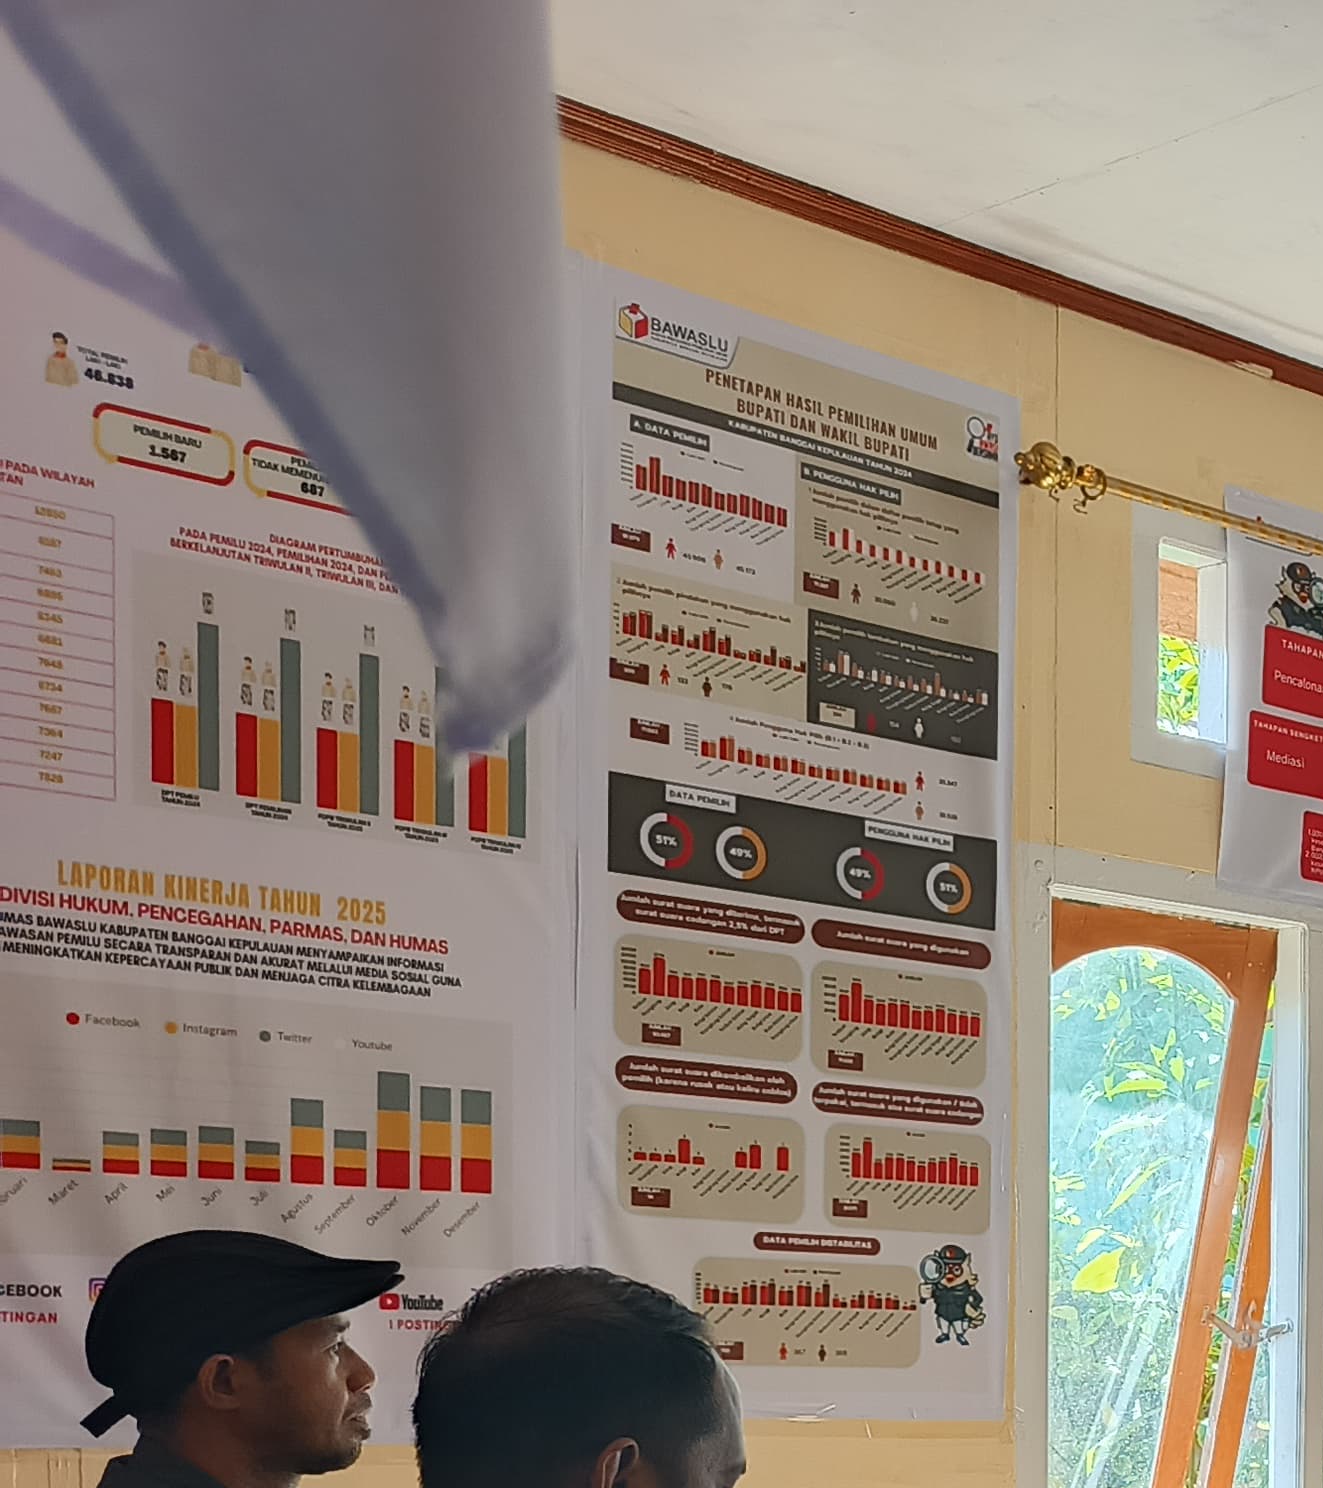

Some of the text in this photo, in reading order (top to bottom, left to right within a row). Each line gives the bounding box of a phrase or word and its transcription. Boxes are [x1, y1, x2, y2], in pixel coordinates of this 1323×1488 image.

[650, 317, 729, 352] BAWASLU
[706, 368, 938, 450] PENETAPAN HASIL PEMILIHAN UMUM
[133, 424, 202, 449] PEMILIH BARU
[644, 423, 671, 438] DATA
[737, 398, 910, 462] BUPATI DAN WAKIL BUPATI
[728, 419, 778, 442] KABUPATEN
[779, 431, 816, 451] BANGGAI
[865, 458, 892, 473] TAHUN
[5, 460, 95, 488] PADA WILAYAH
[252, 458, 279, 473] TIDAK
[281, 465, 329, 485] MEMENU
[858, 481, 878, 493] HAK
[179, 526, 378, 579] PADA PEMILU 2024, PEMILIHAN 2024, DAN
[269, 534, 317, 552] DIAGRAM
[170, 538, 251, 563] BERKELANJUTAN
[253, 555, 304, 574] TRIWULAN
[316, 569, 364, 587] TRIWULAN
[1253, 719, 1288, 735] TAHAPAN
[1266, 750, 1305, 769] Mediasi
[669, 790, 695, 801] DATA
[729, 847, 753, 860] 49%
[849, 867, 872, 880] 49%
[57, 860, 387, 926] LAPORAN KINERJA TAHUN 2025
[0, 886, 55, 908] DIVISI
[350, 929, 386, 947] DAN
[389, 935, 449, 955] HUMAS
[36, 915, 444, 973] BAWASLU KABUPATEN BANGGAI KEPULAUAN MENYAMPAIKAN INFORMASI
[3, 942, 432, 998] MENINGKATKAN KEPERCAYAAN PUBLIK DAN MENJAGA CITRA KELEMBAGAAN
[57, 932, 101, 948] PEMILU
[104, 938, 152, 953] SECARA
[155, 943, 231, 962] TRANSPARAN
[234, 952, 258, 965] DAN
[260, 956, 304, 971] AKURAT
[306, 961, 352, 975] MELALUI
[355, 967, 389, 980] MEDIA
[391, 970, 429, 984] SOSIAL
[432, 975, 462, 988] GUNA
[85, 1014, 140, 1029] Facebook
[183, 1023, 238, 1038] Instagram
[278, 1031, 313, 1044] Twitter
[352, 1039, 393, 1051] Youtube
[49, 1179, 80, 1206] Maret
[103, 1182, 129, 1206] April
[155, 1184, 176, 1203] Mei
[200, 1187, 223, 1207] Juni
[280, 1193, 314, 1225] Agustus
[314, 1194, 356, 1236] September
[366, 1195, 399, 1228] Oktober
[401, 1198, 443, 1237] November
[443, 1201, 482, 1239] Desember
[401, 1294, 444, 1311] YouTube
